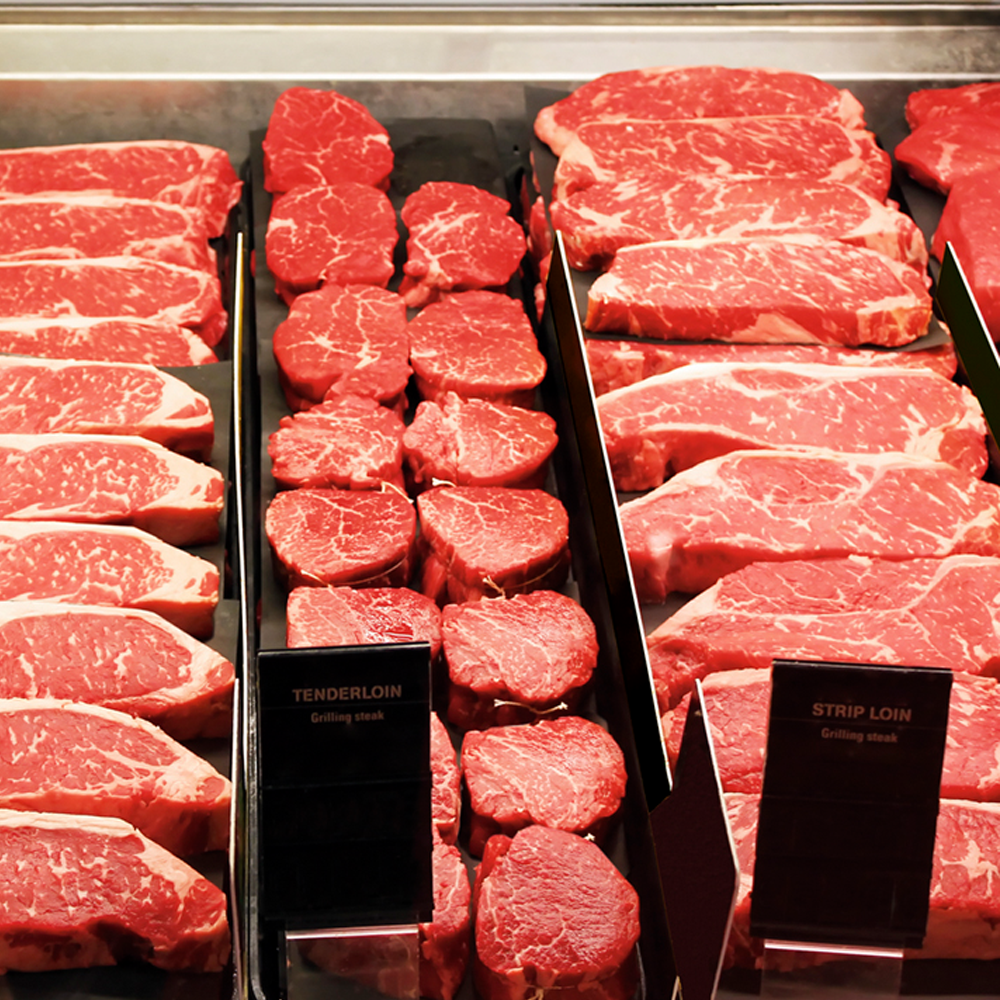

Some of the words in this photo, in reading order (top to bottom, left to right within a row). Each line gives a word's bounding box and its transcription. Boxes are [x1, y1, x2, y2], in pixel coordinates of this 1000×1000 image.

[292, 684, 402, 702] TENDERLOIN
[311, 711, 352, 724] Grilling
[354, 710, 385, 722] steak
[812, 702, 865, 719] STRIP
[869, 707, 912, 722] LOIN
[821, 727, 864, 743] Grilling
[866, 732, 898, 743] steak
